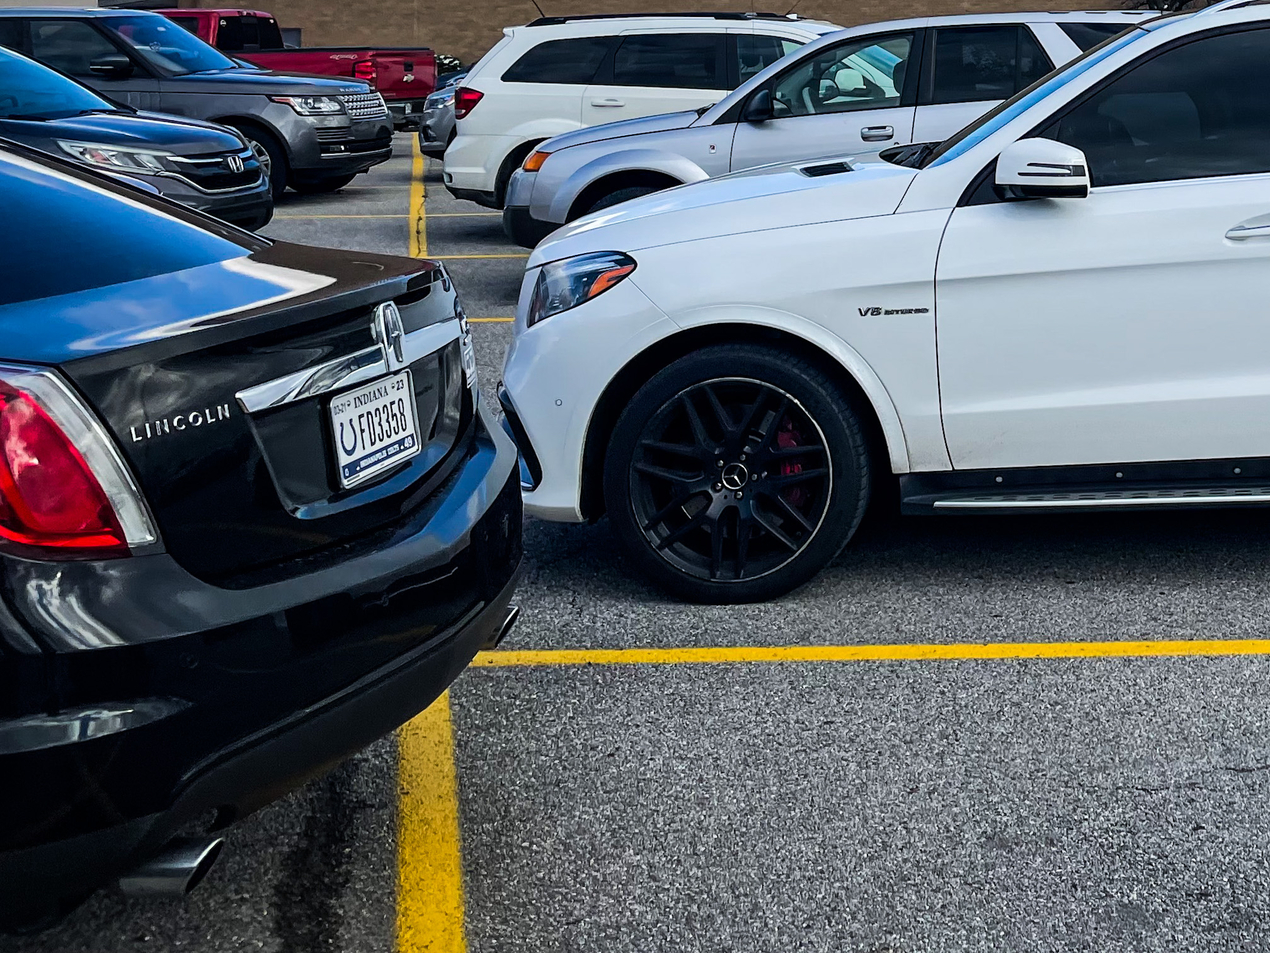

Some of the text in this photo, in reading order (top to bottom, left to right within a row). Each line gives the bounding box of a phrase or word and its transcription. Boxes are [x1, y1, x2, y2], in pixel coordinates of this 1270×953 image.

[858, 307, 882, 317] V8
[353, 386, 389, 409] INDIANA
[396, 379, 405, 391] 23
[130, 404, 231, 442] LINCOLN
[358, 398, 407, 450] FD3358
[403, 436, 413, 448] 49
